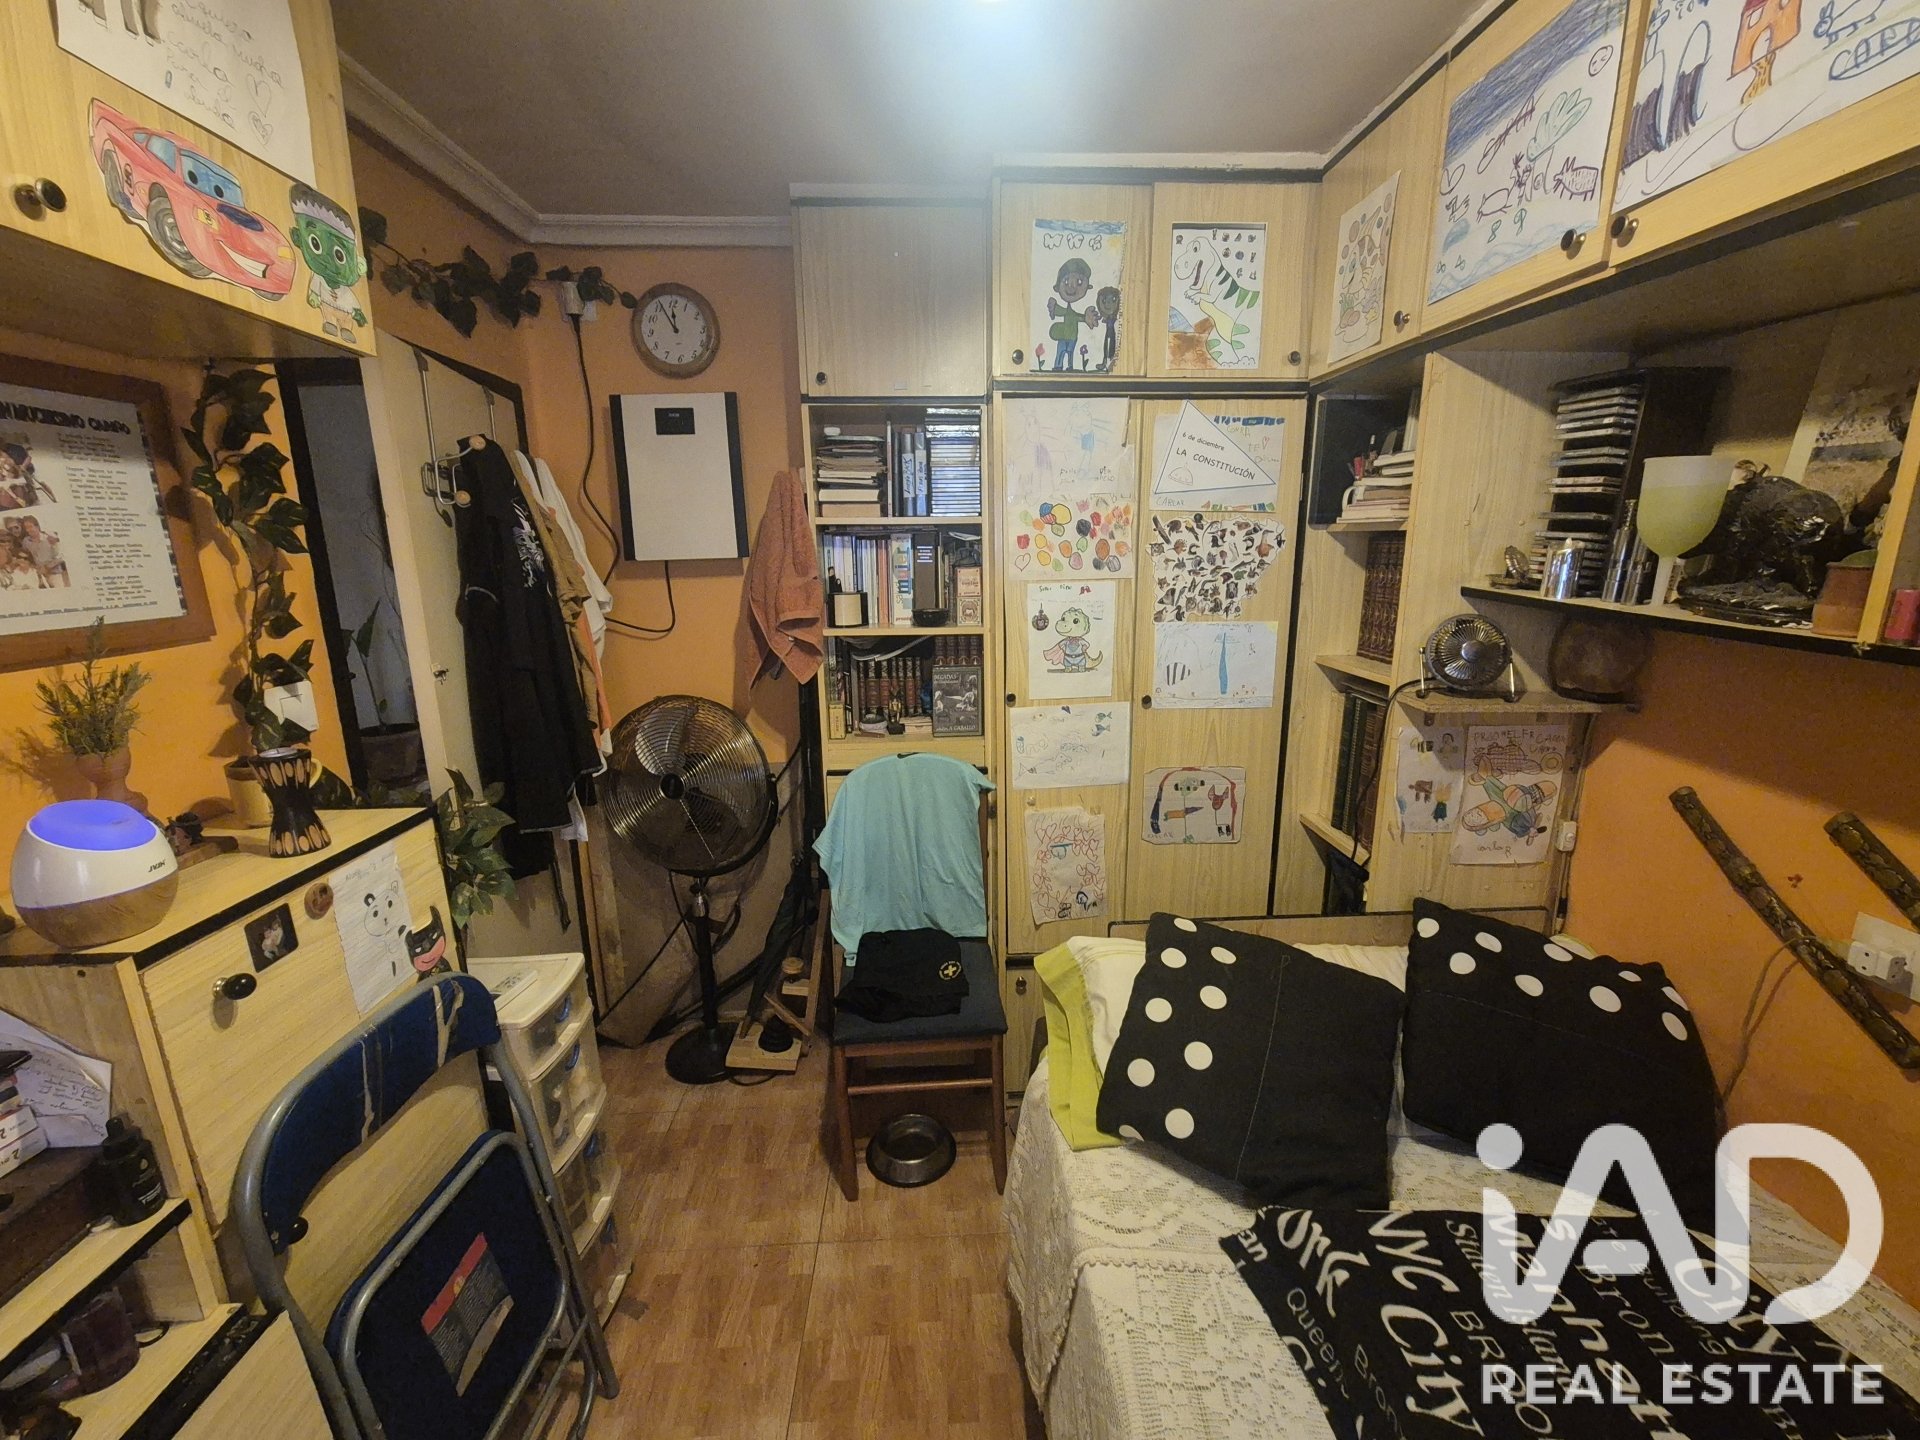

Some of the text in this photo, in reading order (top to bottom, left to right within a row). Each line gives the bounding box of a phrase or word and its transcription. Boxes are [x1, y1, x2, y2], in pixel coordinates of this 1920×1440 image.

[1176, 447, 1256, 480] LA CONSTITUCIÓN
[1188, 434, 1196, 442] de
[1197, 436, 1225, 451] diciembre
[1270, 1207, 1371, 1319] ork
[1357, 1209, 1461, 1293] NYC
[1445, 1219, 1513, 1300] Staten
[1674, 1257, 1807, 1363] City
[1354, 1343, 1404, 1440] Bron
[1381, 1305, 1485, 1437] City
[1450, 1311, 1560, 1440] BROO
